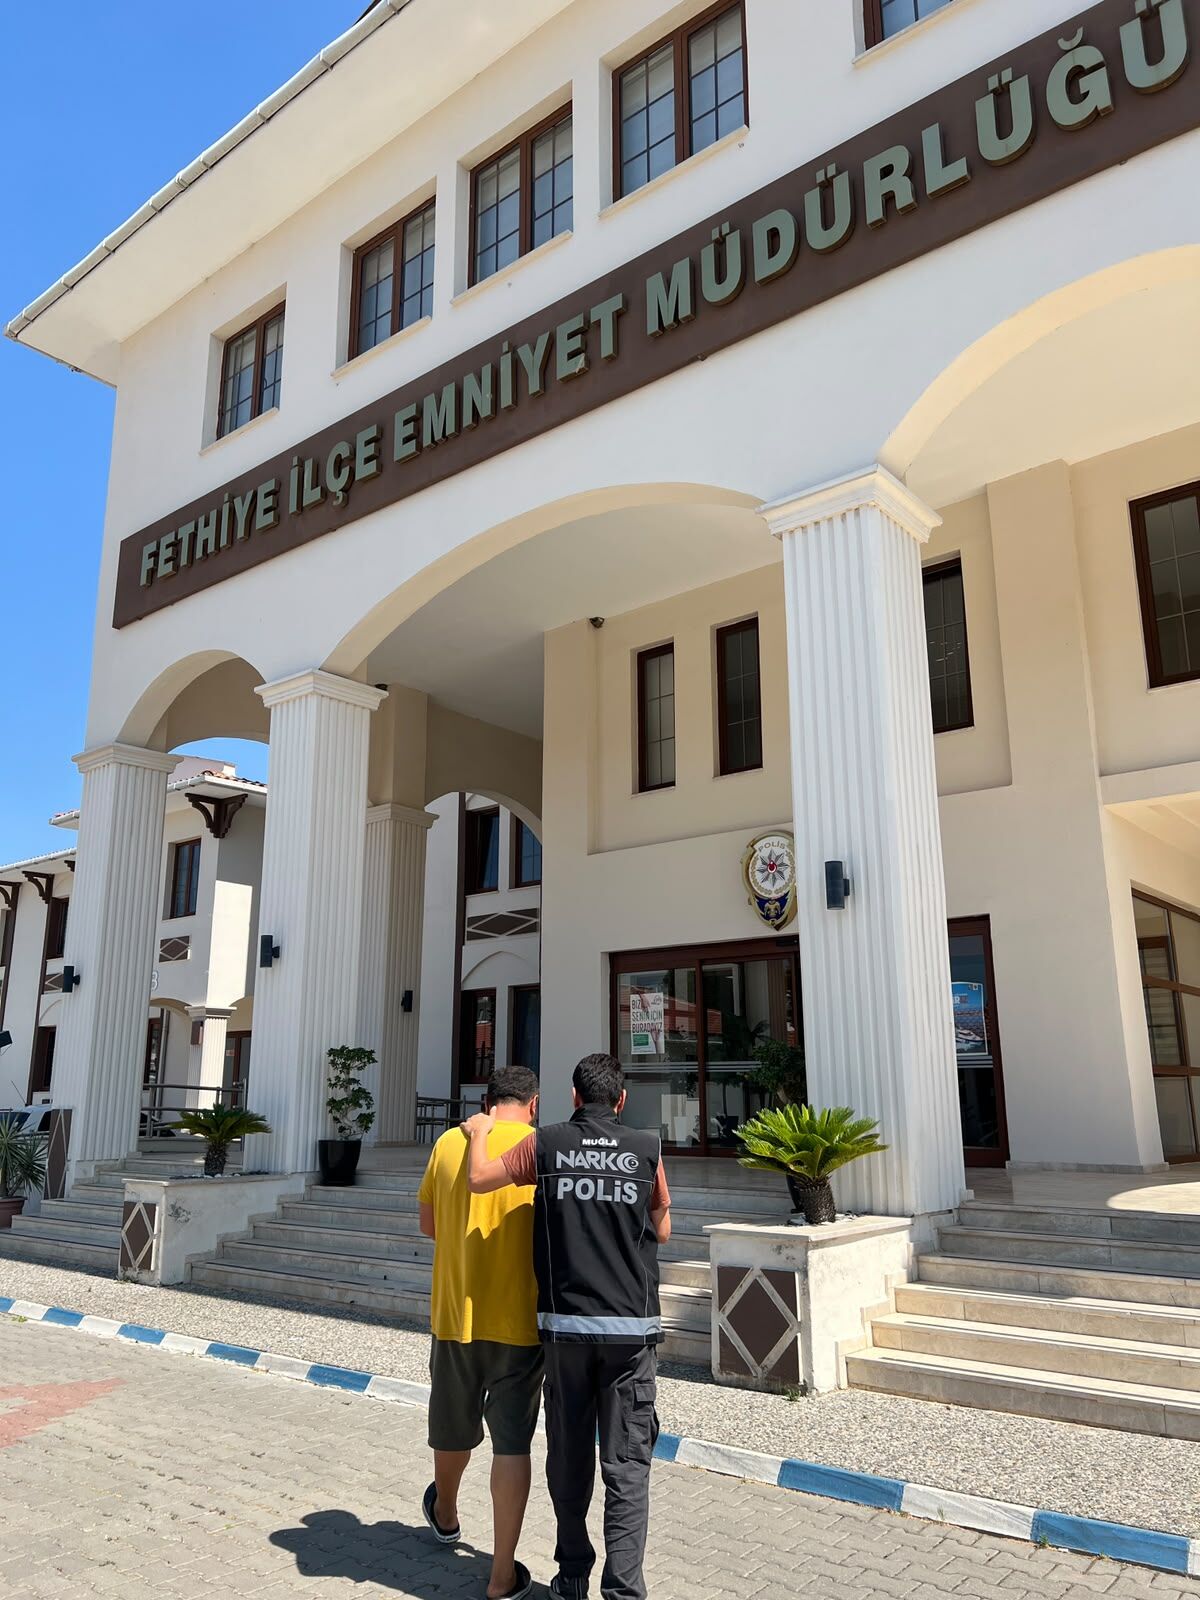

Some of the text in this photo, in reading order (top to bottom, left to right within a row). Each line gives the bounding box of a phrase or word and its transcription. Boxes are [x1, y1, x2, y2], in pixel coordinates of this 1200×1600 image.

[140, 0, 1191, 588] FETHİYE İLÇE EMNİYET MÜDÜRLÜĞÜ
